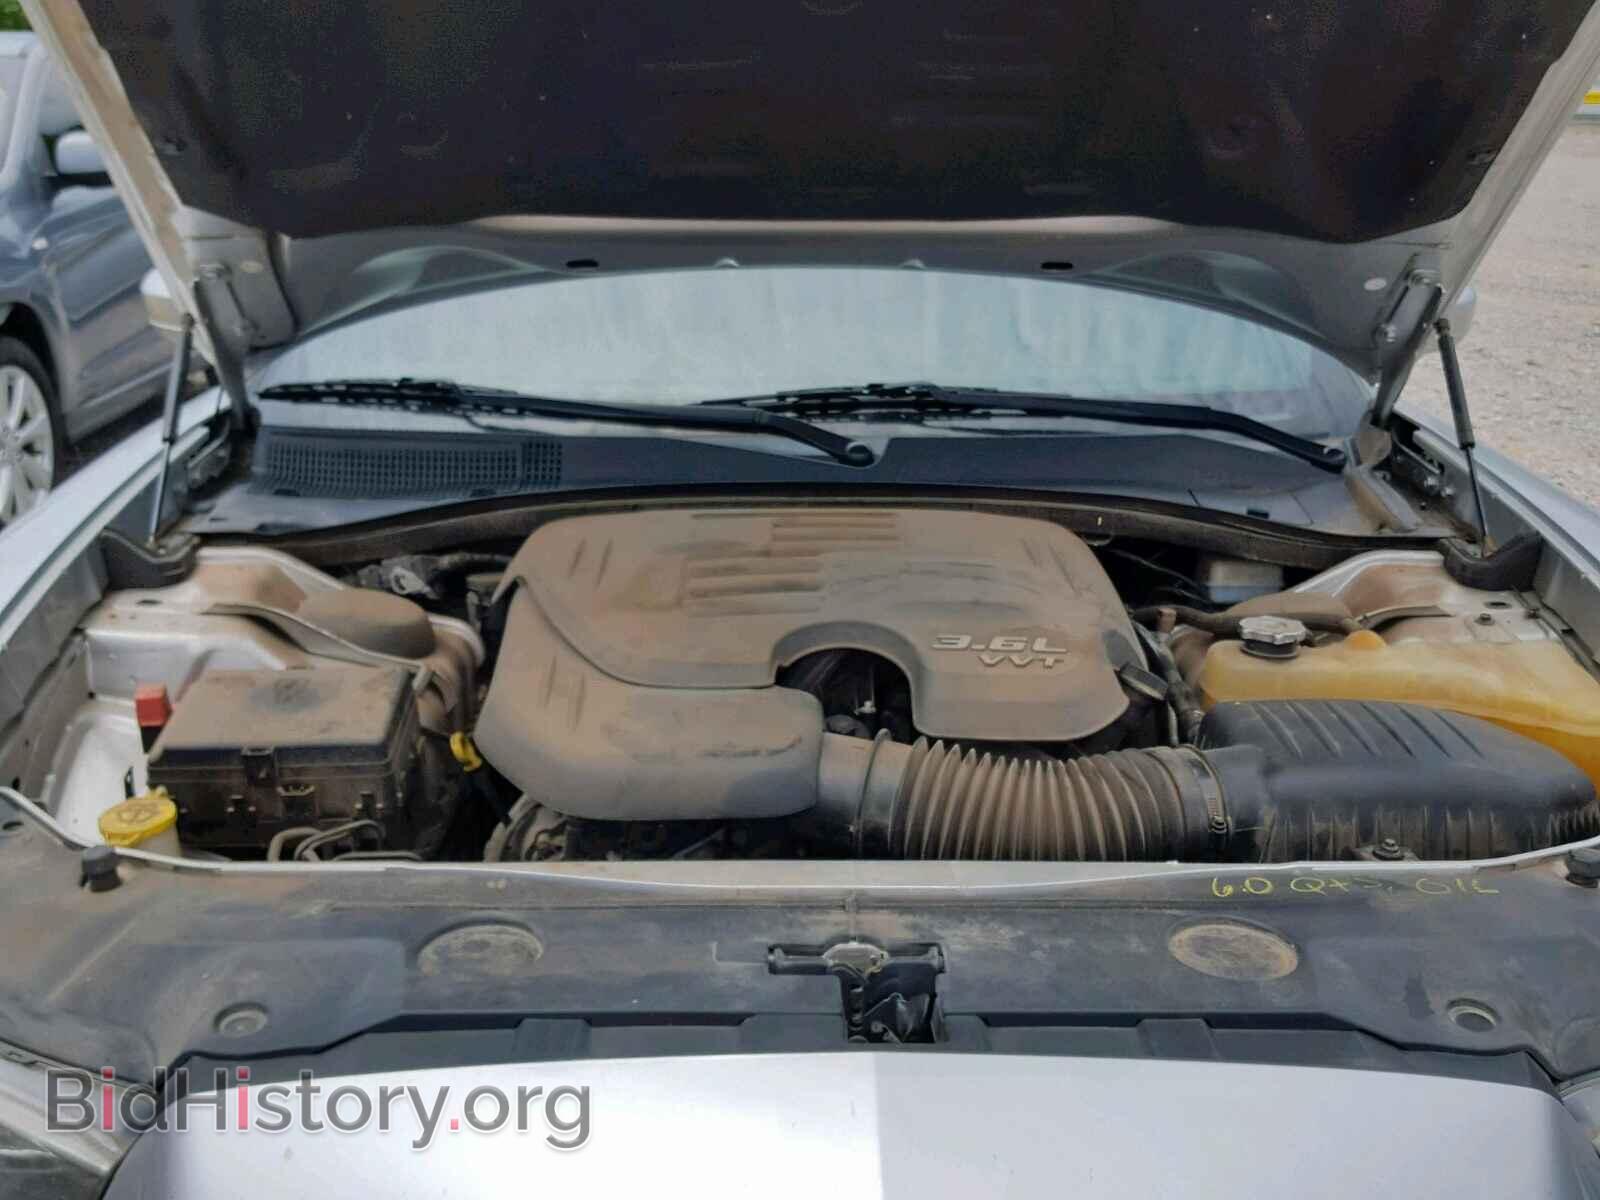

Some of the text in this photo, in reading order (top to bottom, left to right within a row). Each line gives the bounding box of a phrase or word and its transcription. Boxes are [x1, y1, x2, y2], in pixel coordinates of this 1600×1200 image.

[931, 633, 1068, 654] 3.6L
[977, 654, 1065, 670] VVT
[1211, 876, 1274, 897] 6.0
